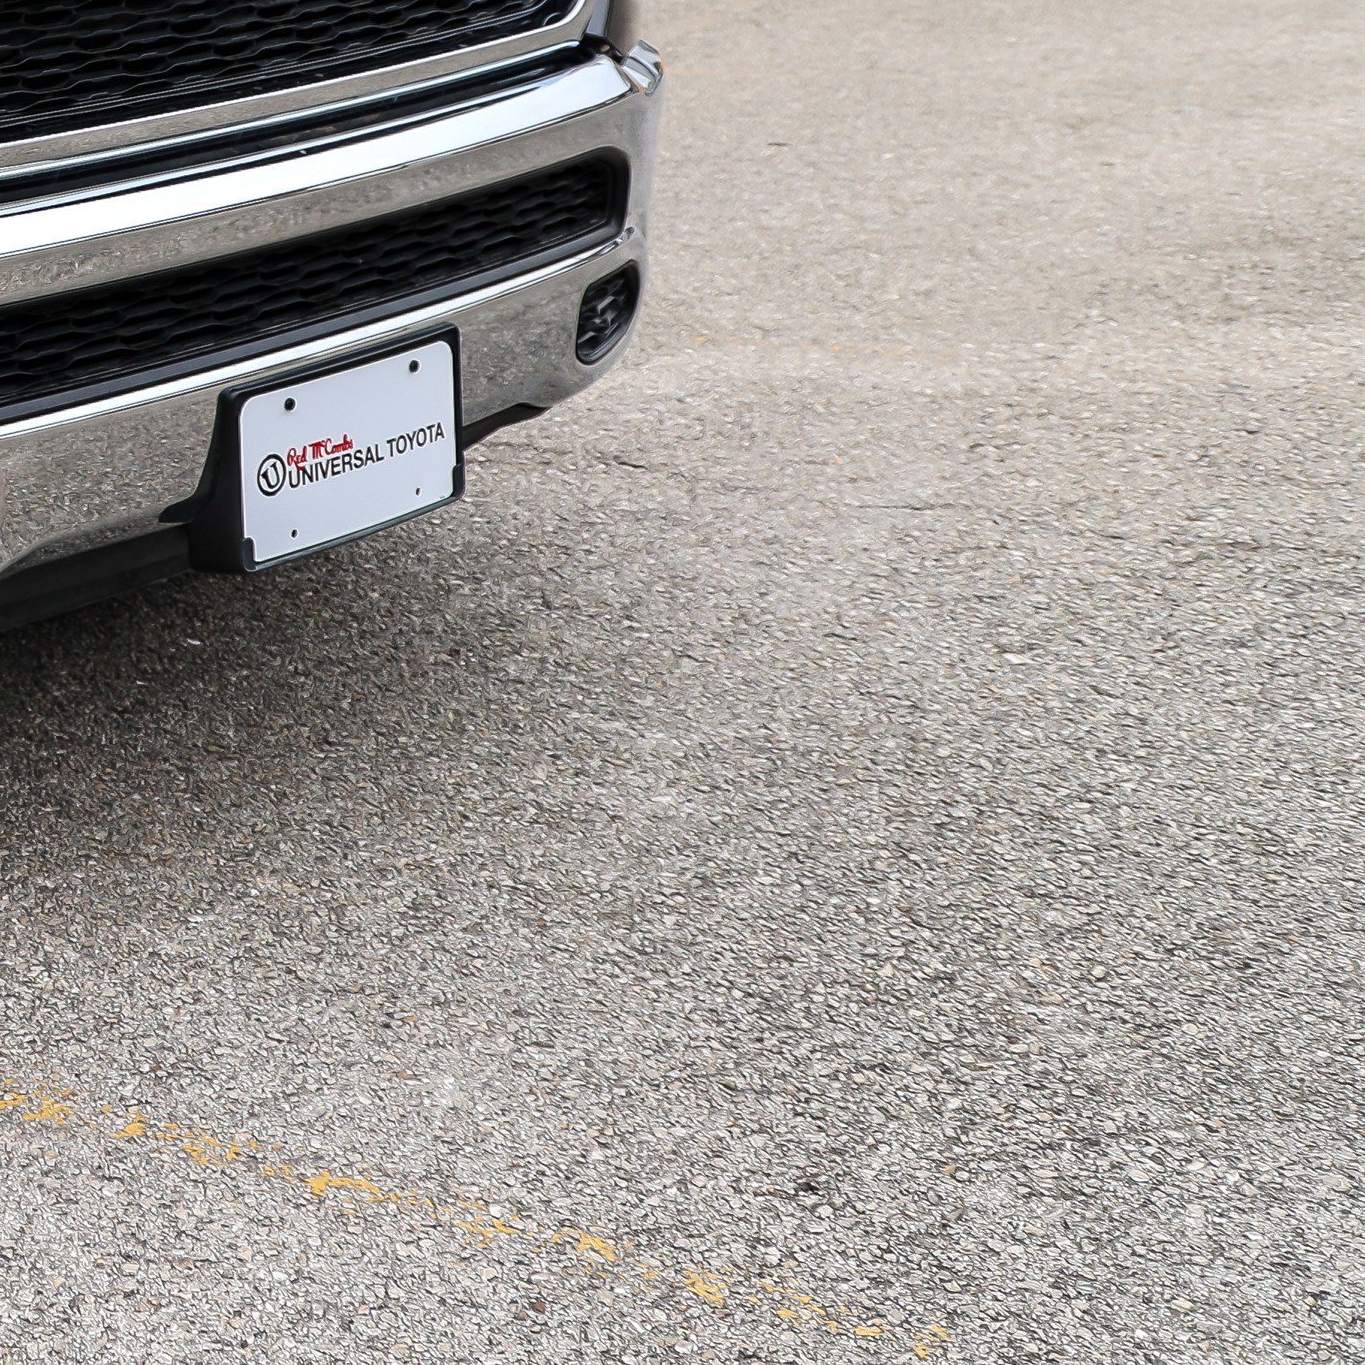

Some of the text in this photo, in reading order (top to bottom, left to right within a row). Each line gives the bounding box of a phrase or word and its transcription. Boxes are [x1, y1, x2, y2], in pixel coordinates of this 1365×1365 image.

[287, 447, 308, 471] Red
[288, 422, 445, 489] UNIVERSAL TOYOTA
